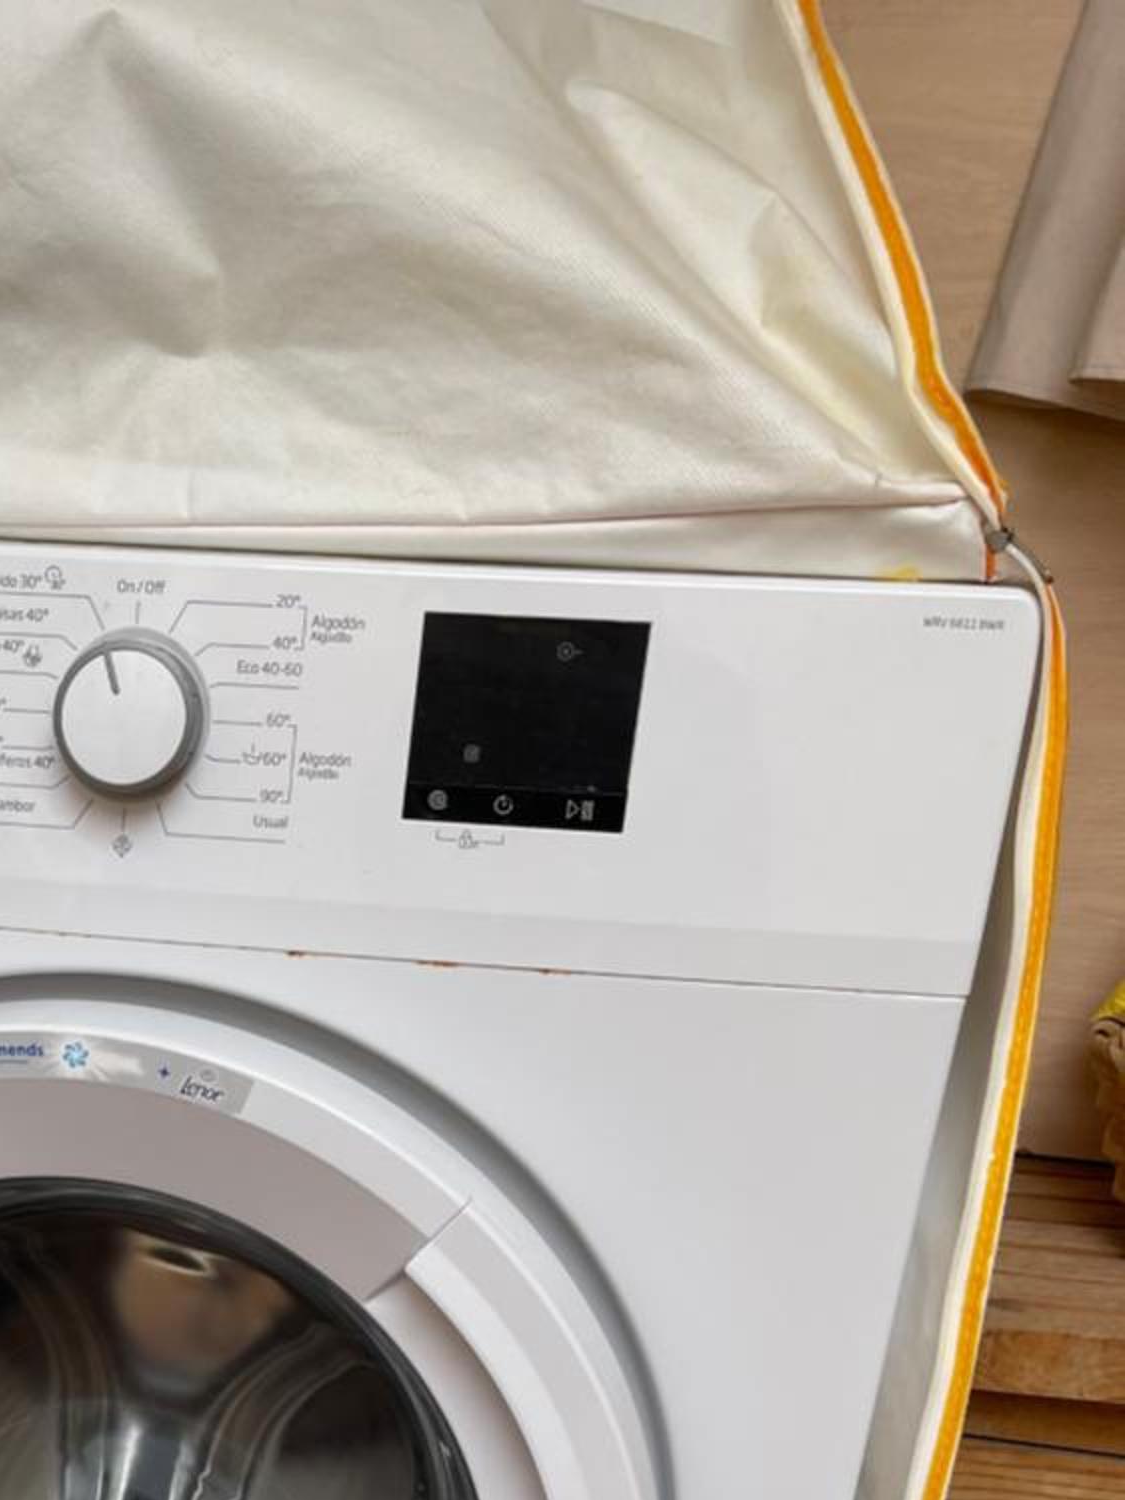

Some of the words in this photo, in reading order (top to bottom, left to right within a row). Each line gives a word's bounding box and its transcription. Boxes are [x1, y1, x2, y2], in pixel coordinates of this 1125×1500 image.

[116, 579, 135, 593] On
[144, 580, 166, 594] Off
[237, 660, 260, 674] Eco
[262, 661, 303, 677] 40-60
[253, 814, 290, 829] Usual
